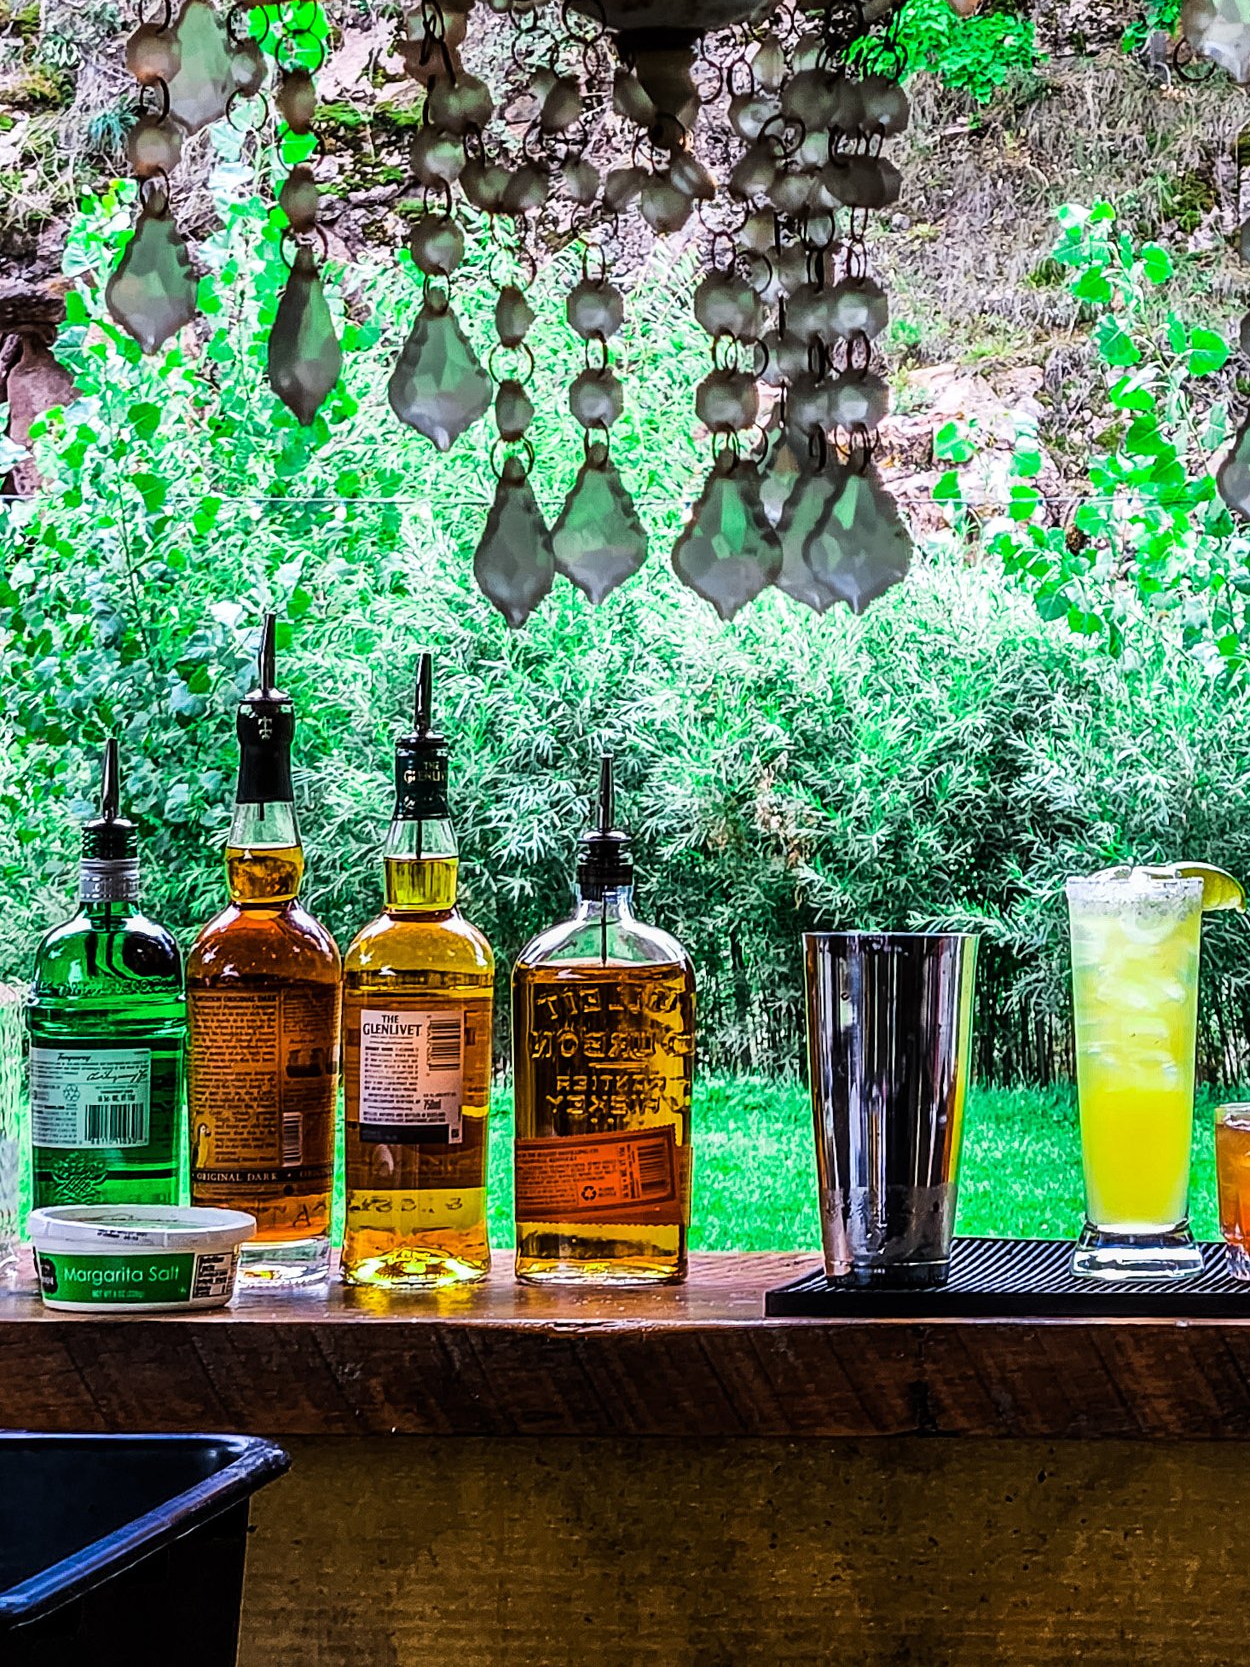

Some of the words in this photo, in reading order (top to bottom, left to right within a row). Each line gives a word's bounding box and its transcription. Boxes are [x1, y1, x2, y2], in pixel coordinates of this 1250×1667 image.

[381, 1015, 399, 1024] THE
[363, 1023, 422, 1037] GLENLIVET
[197, 1173, 243, 1182] ORIGINAL
[247, 1172, 278, 1181] DARK
[63, 1266, 143, 1286] Margarita
[148, 1265, 179, 1282] Salt
